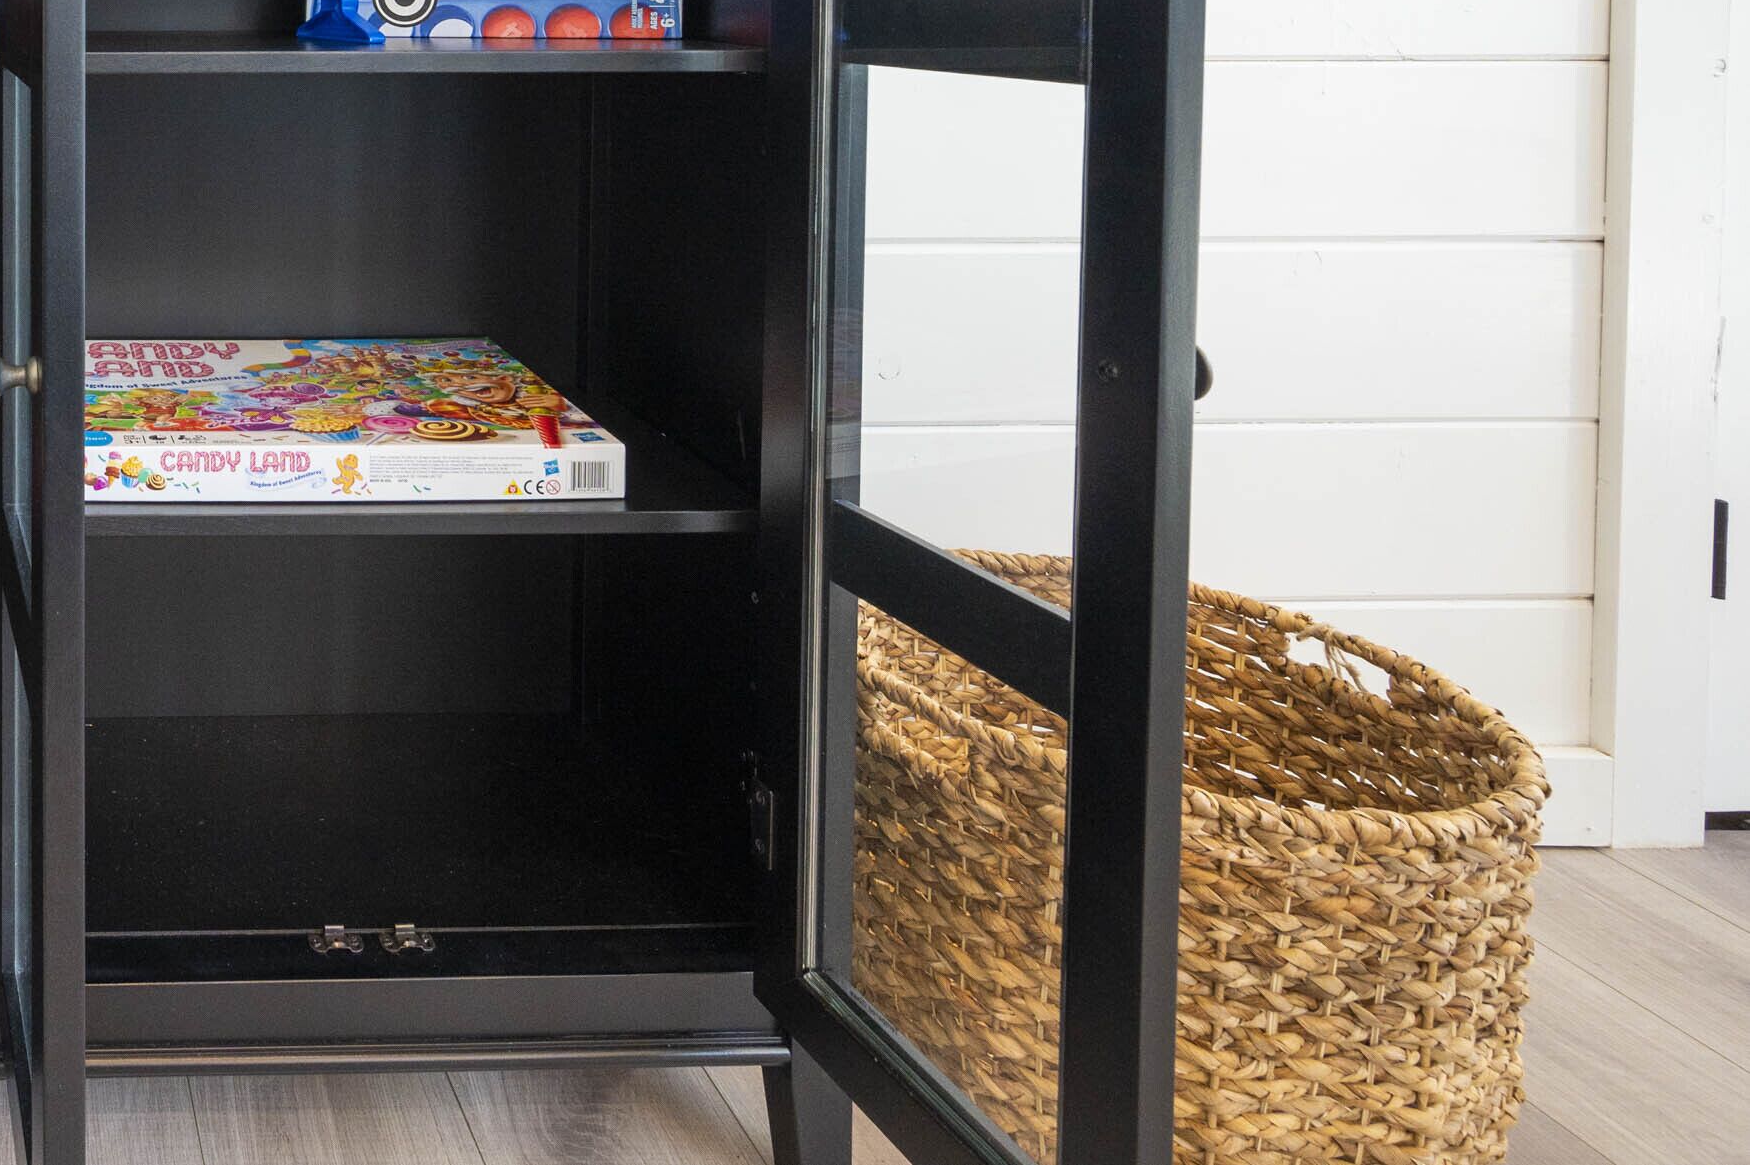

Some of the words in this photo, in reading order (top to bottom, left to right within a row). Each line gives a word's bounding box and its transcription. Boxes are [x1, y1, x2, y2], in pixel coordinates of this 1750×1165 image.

[650, 12, 658, 29] AGES
[86, 342, 240, 360] ANDY
[160, 450, 241, 472] CANDY
[250, 450, 311, 473] LAND
[250, 480, 271, 488] Kingdom
[295, 470, 322, 481] Adventures
